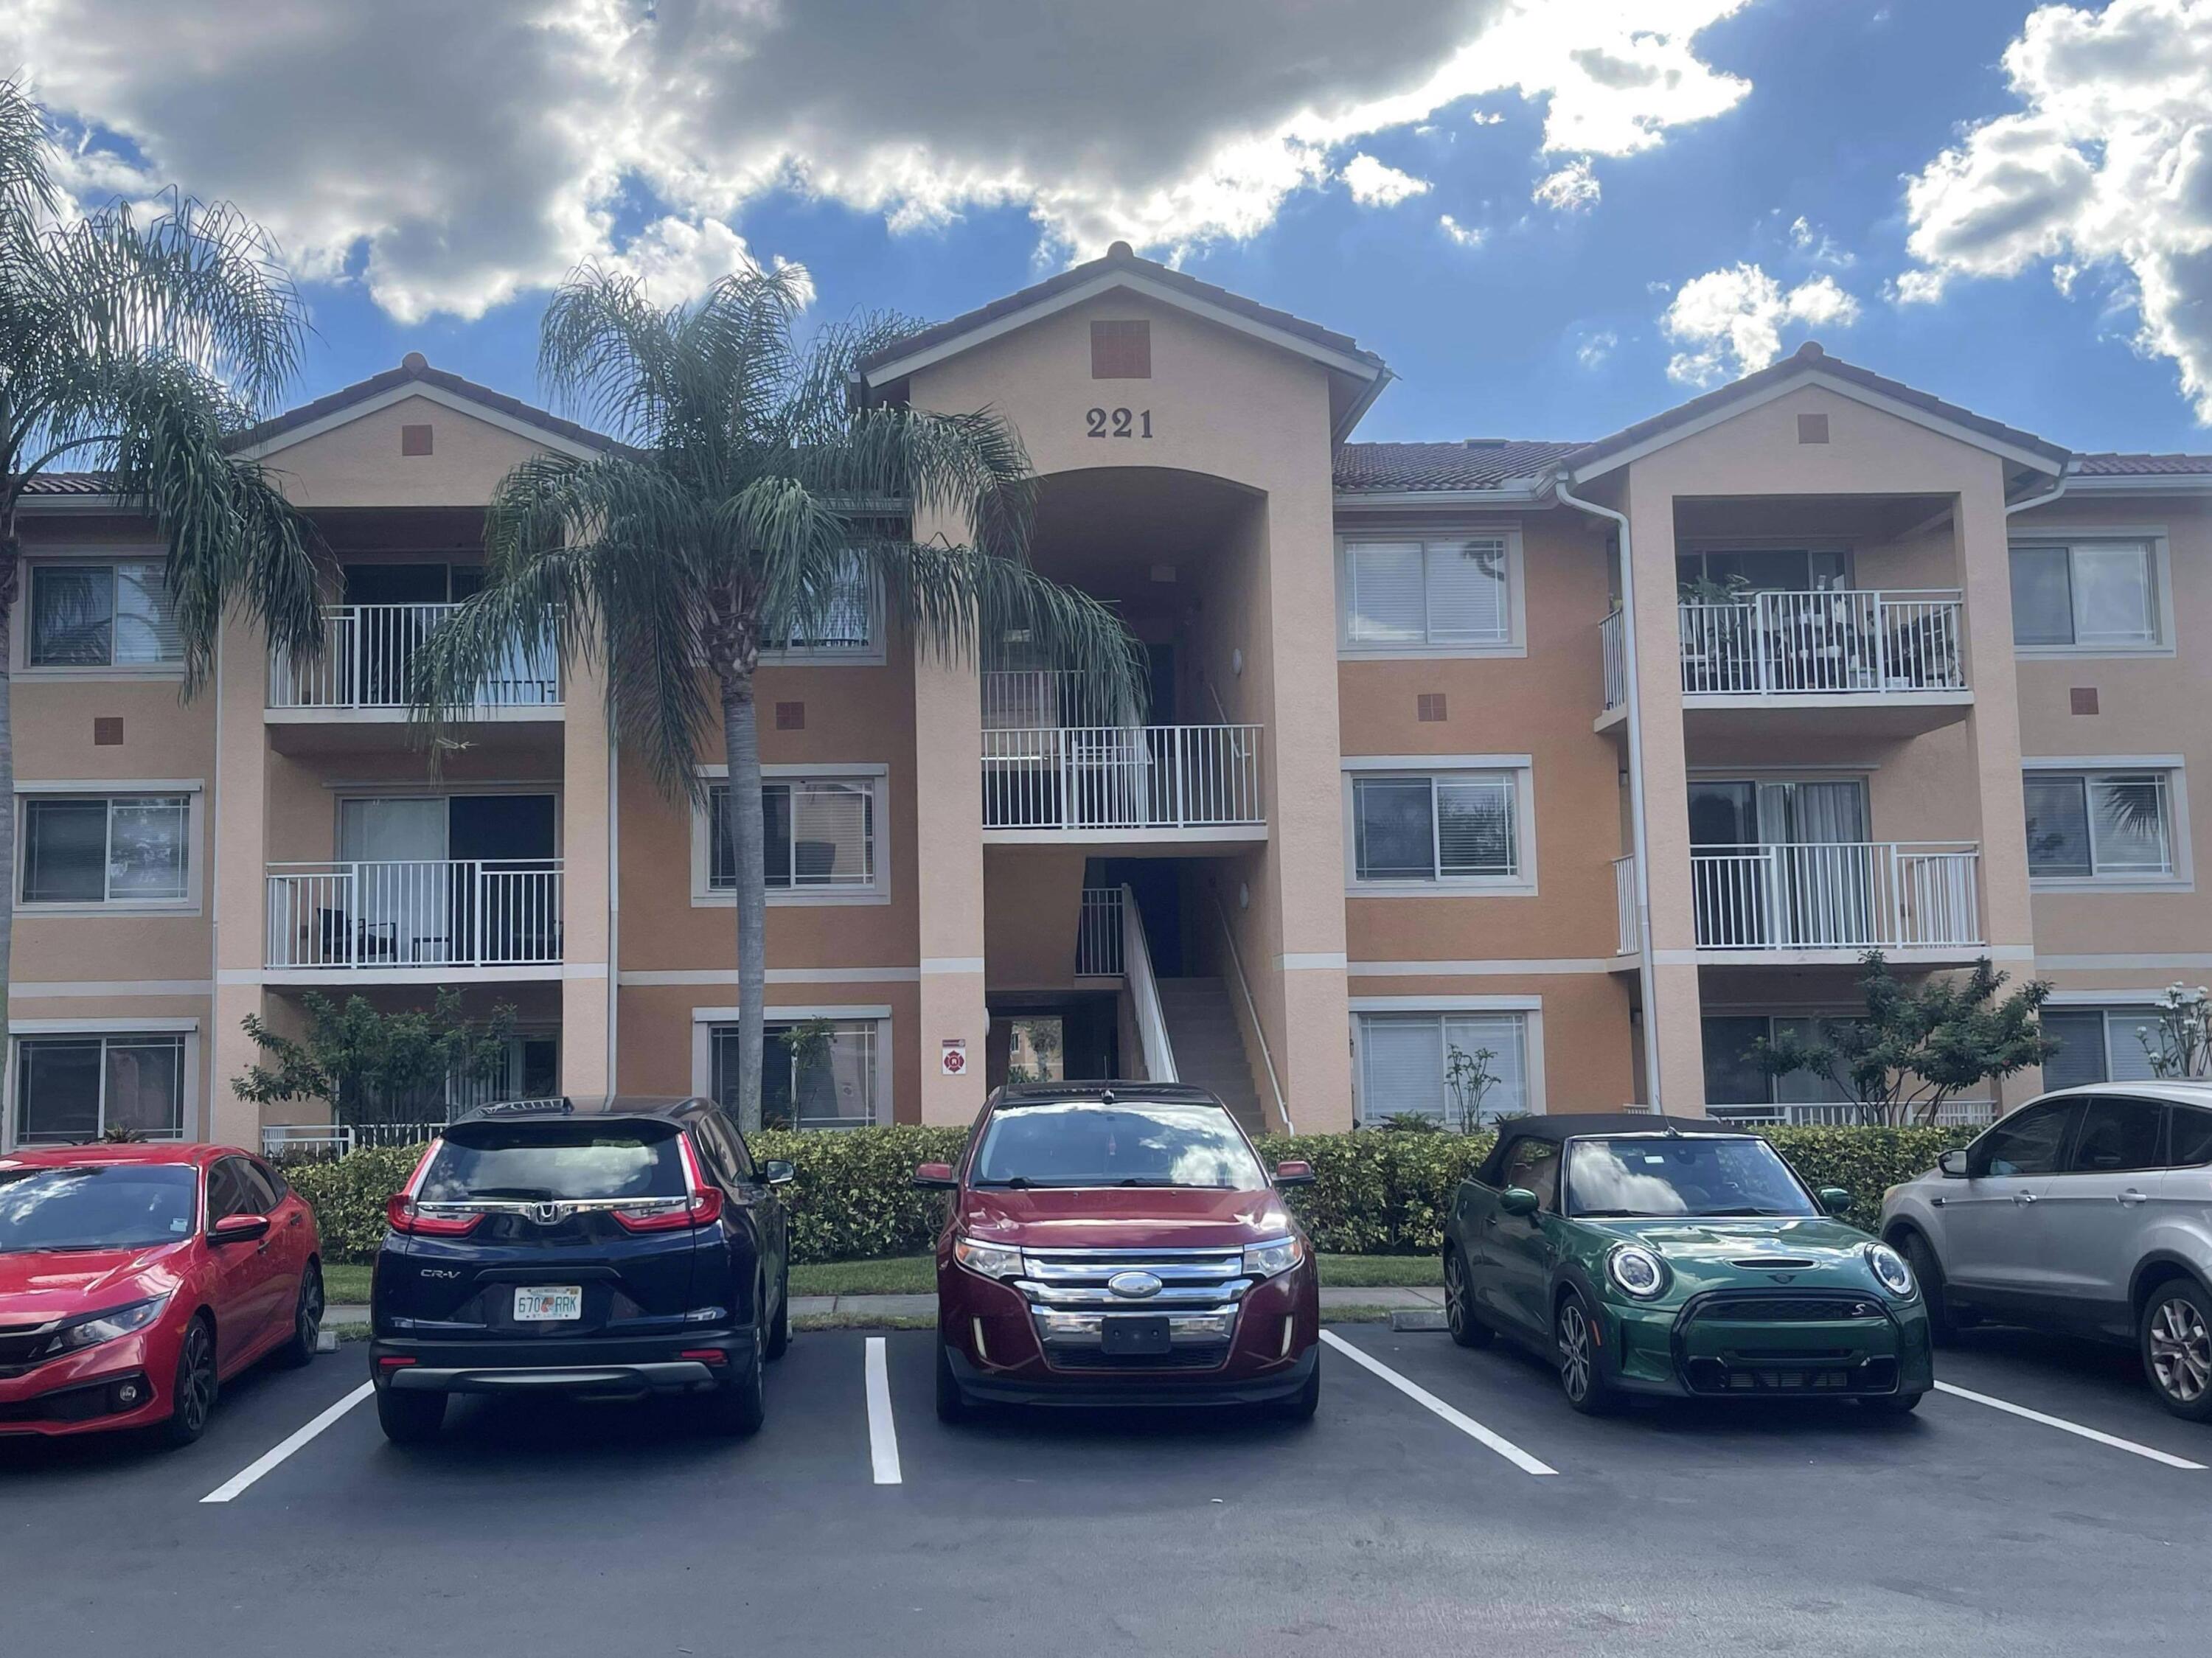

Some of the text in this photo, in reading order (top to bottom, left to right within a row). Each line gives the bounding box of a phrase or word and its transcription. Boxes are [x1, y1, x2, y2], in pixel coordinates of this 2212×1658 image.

[1086, 407, 1153, 438] 221
[420, 1269, 461, 1278] CR-V
[518, 1297, 540, 1313] 670
[1851, 1303, 1865, 1315] S
